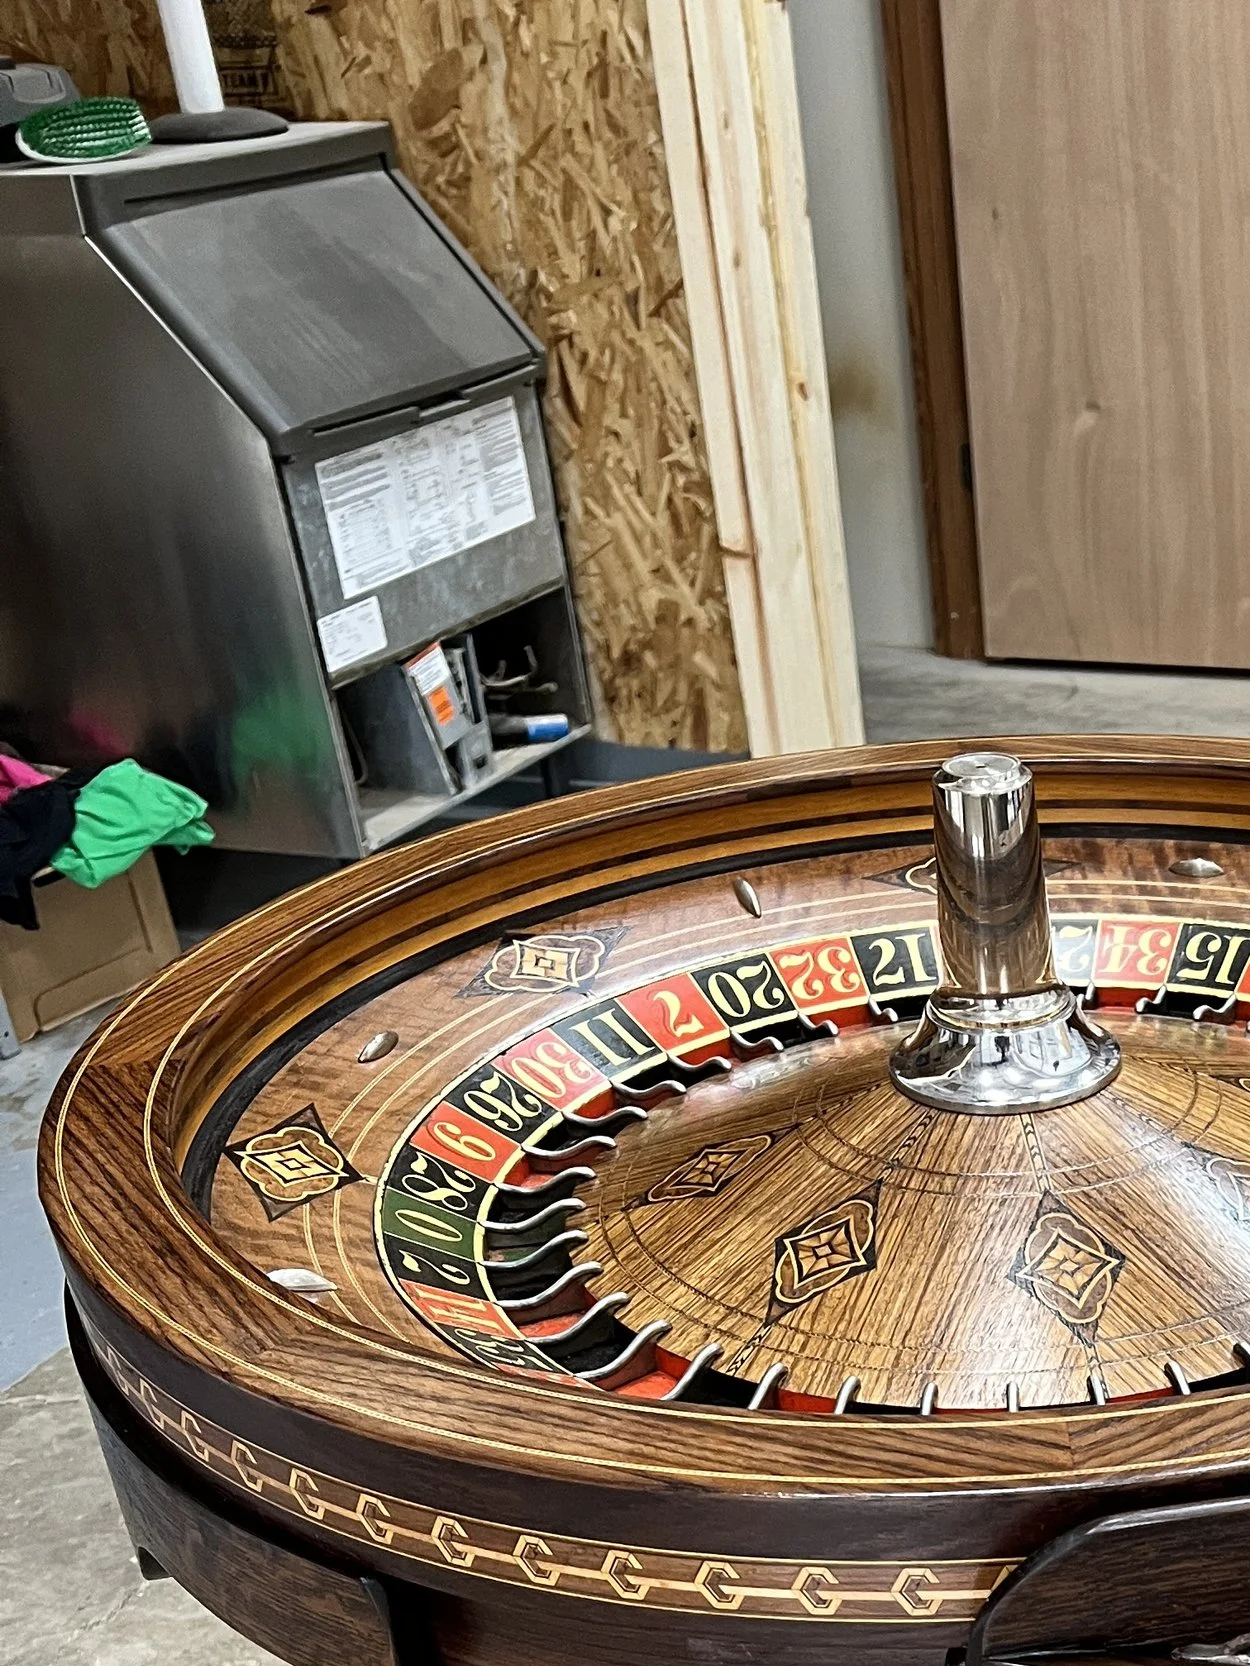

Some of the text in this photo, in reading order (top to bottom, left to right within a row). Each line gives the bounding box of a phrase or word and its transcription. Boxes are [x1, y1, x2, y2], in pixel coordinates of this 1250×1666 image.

[779, 945, 862, 1001] 32
[868, 932, 938, 987] 17
[1100, 924, 1173, 976] 34
[652, 989, 704, 1038] 7
[707, 959, 786, 1019] 20
[568, 1007, 657, 1067] 11
[510, 1040, 591, 1100] 30
[463, 1070, 542, 1132] 26
[433, 1121, 497, 1162] 9
[401, 1150, 476, 1211] 28
[394, 1208, 463, 1242] 0
[398, 1249, 471, 1285] 2
[411, 1285, 508, 1336] 14
